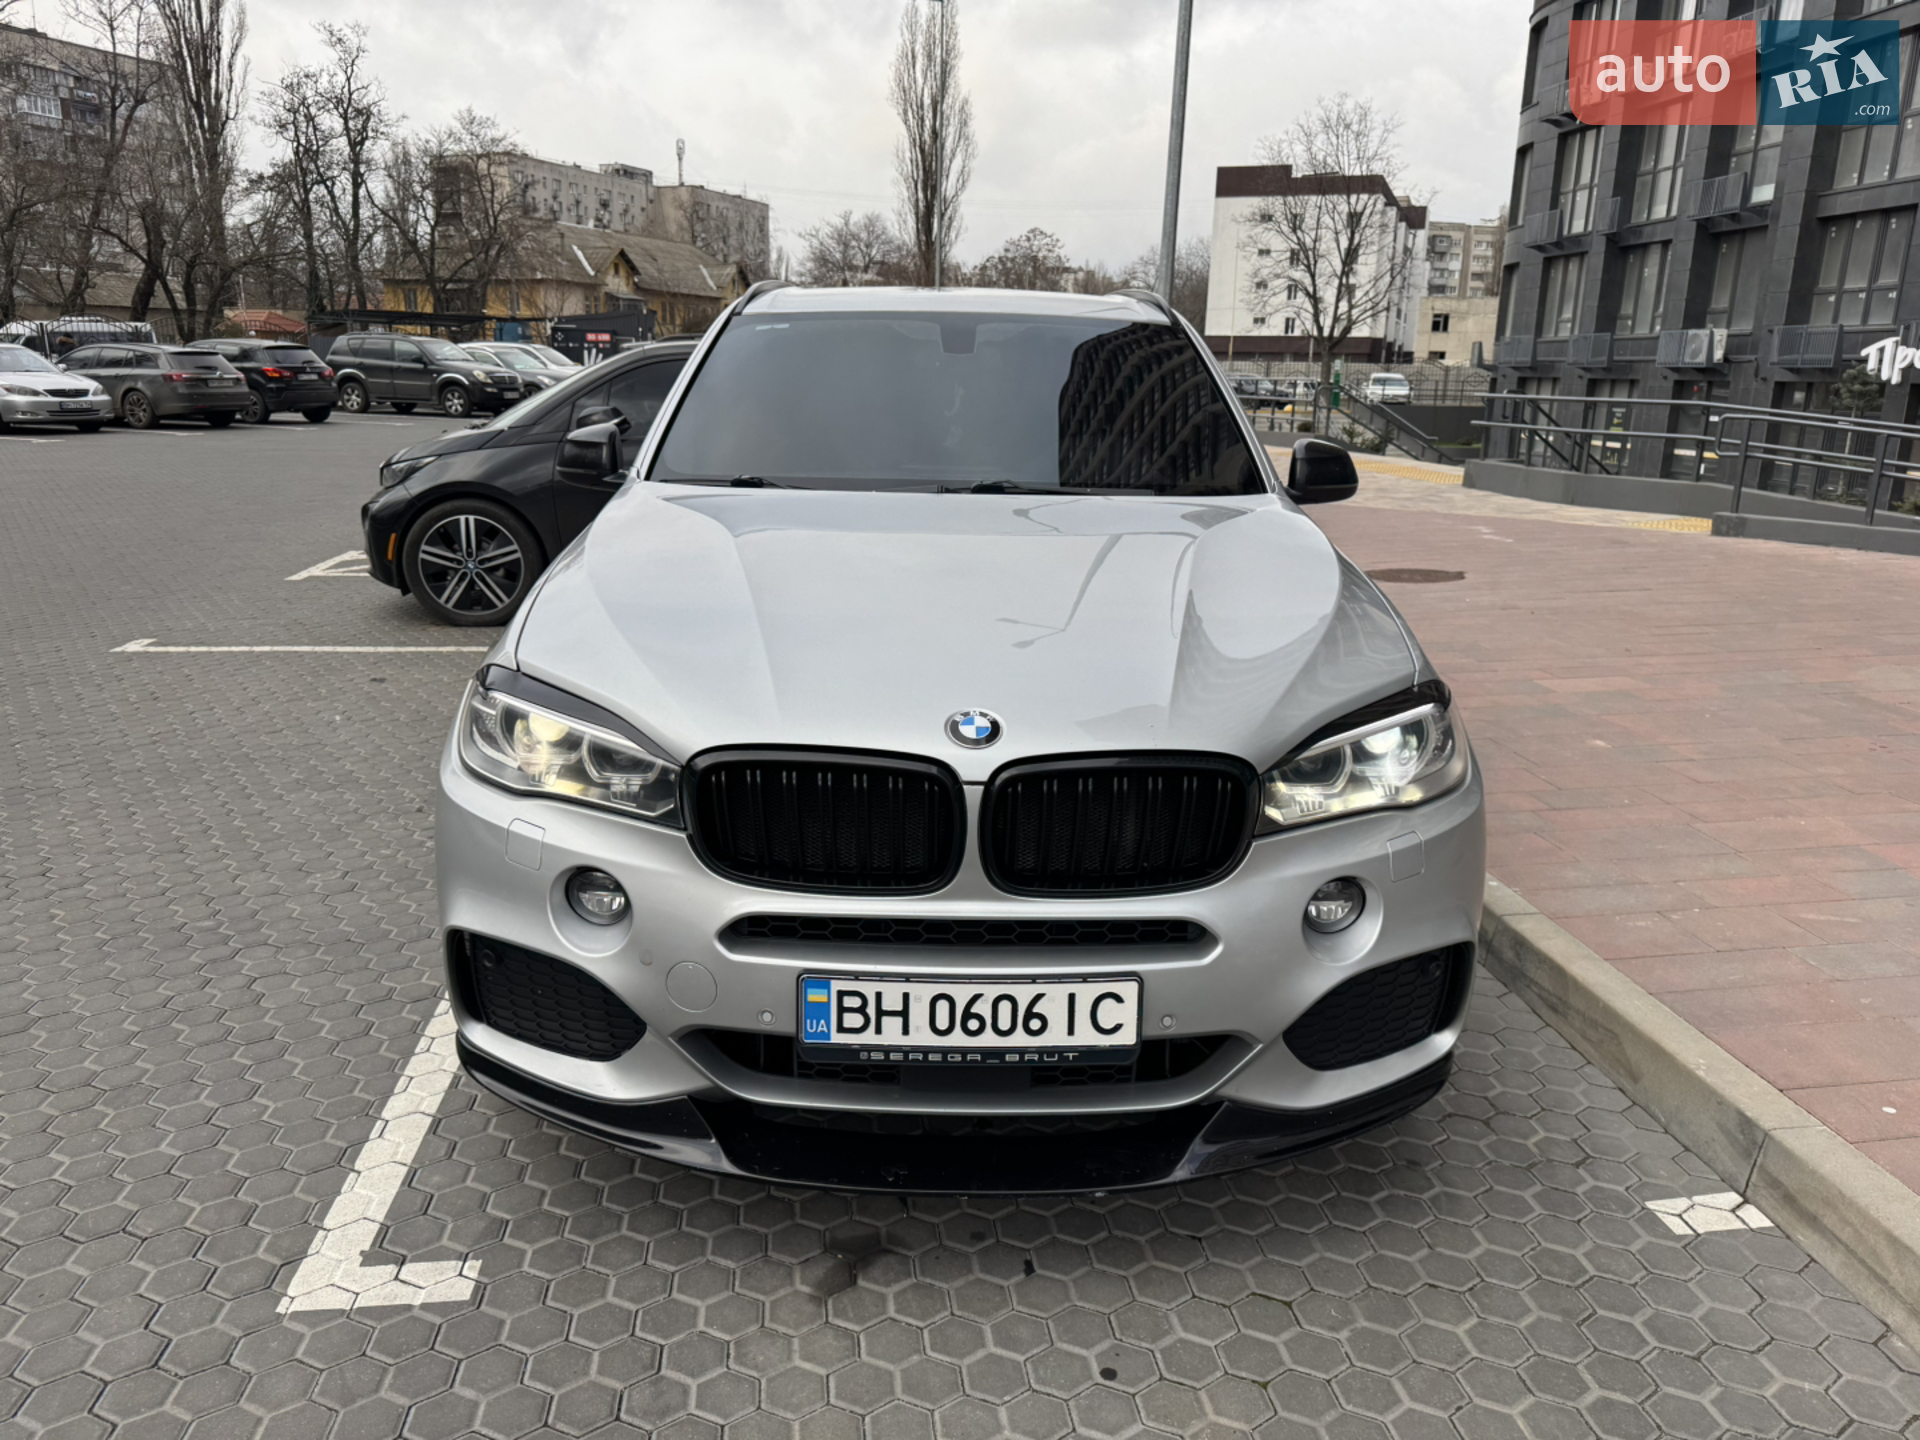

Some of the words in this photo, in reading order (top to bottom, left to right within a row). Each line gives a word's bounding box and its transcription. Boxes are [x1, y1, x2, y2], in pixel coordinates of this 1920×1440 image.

[807, 1019, 828, 1033] UA
[836, 989, 910, 1036] BH
[928, 991, 1049, 1037] 0606
[1067, 991, 1125, 1037] IC
